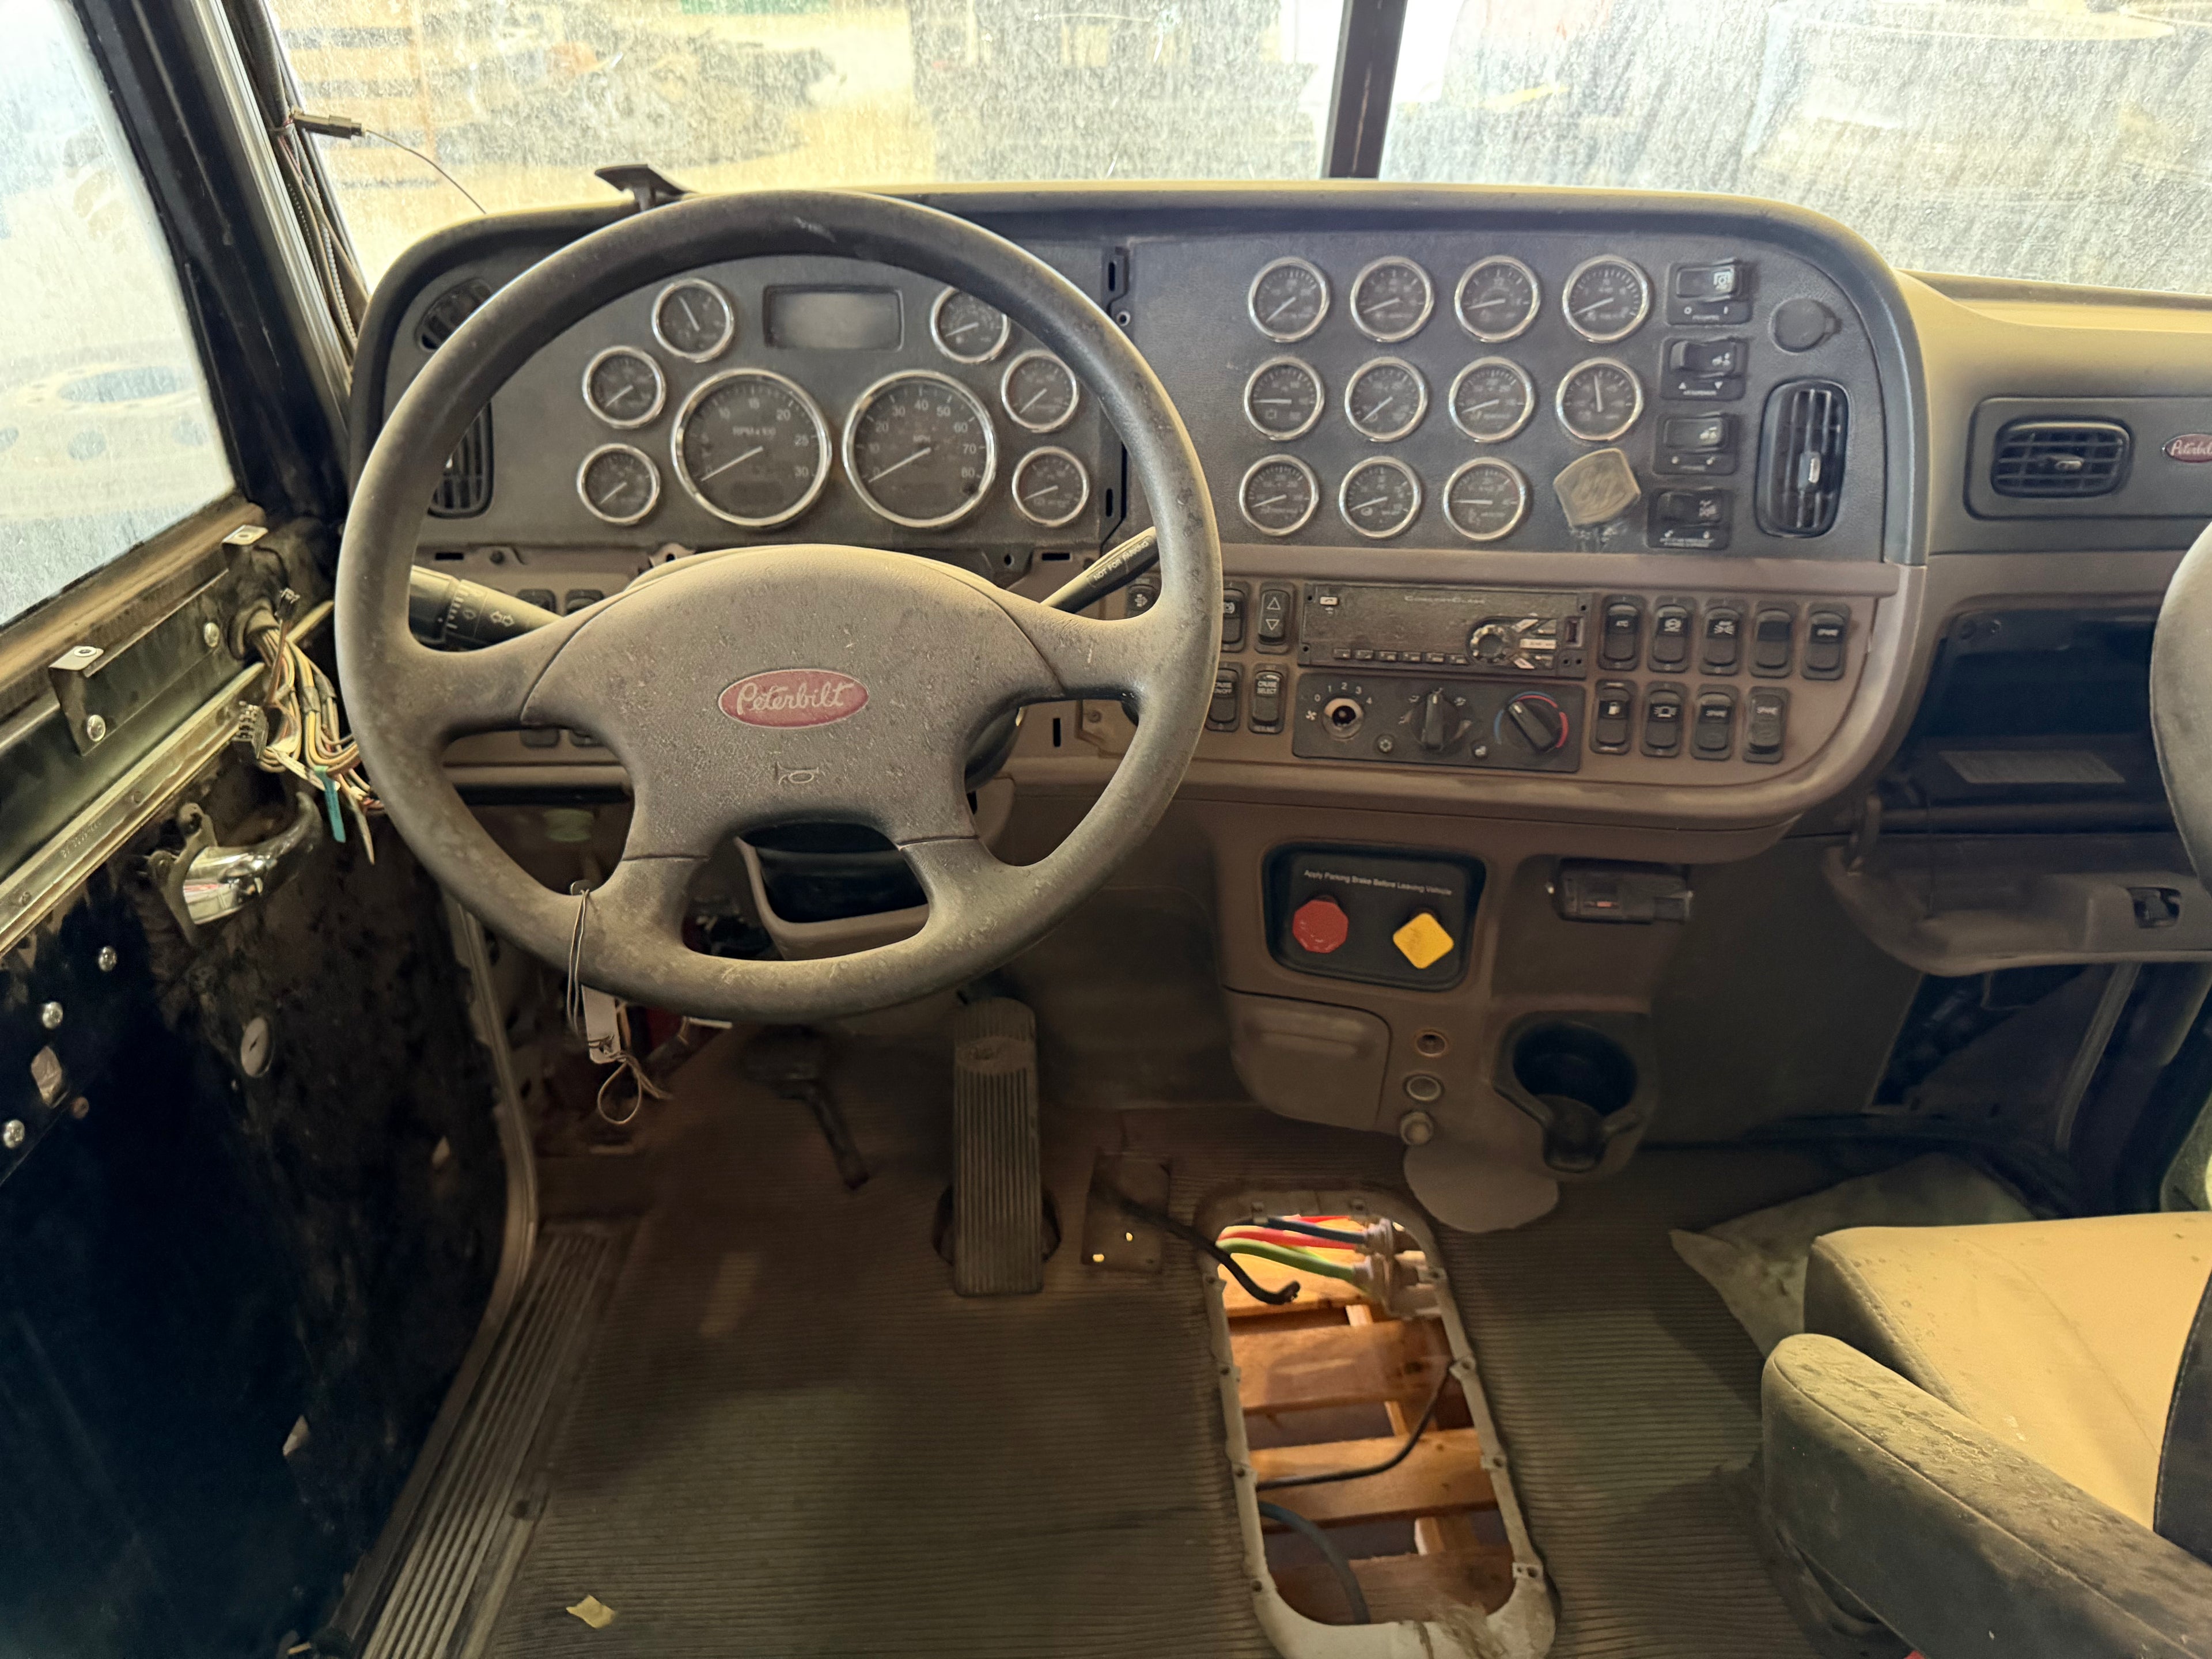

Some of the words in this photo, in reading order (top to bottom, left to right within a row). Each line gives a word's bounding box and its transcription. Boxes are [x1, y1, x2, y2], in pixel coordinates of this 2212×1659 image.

[914, 400, 929, 411] 40
[937, 406, 950, 416] 50
[777, 410, 791, 421] 20
[893, 407, 906, 416] 30
[876, 422, 889, 433] 20
[954, 422, 968, 433] 60
[794, 435, 809, 446] 25
[869, 443, 880, 453] 10
[963, 444, 977, 454] 70
[2171, 440, 2212, 456] Peterbil
[794, 466, 809, 478] 30
[1093, 567, 1107, 581] NOT
[1107, 559, 1123, 571] FOR
[1341, 682, 1347, 690] 2
[1355, 686, 1362, 695] 3
[737, 681, 854, 715] Peterbilt
[1304, 870, 1323, 880] Apply
[1324, 872, 1350, 884] Parking
